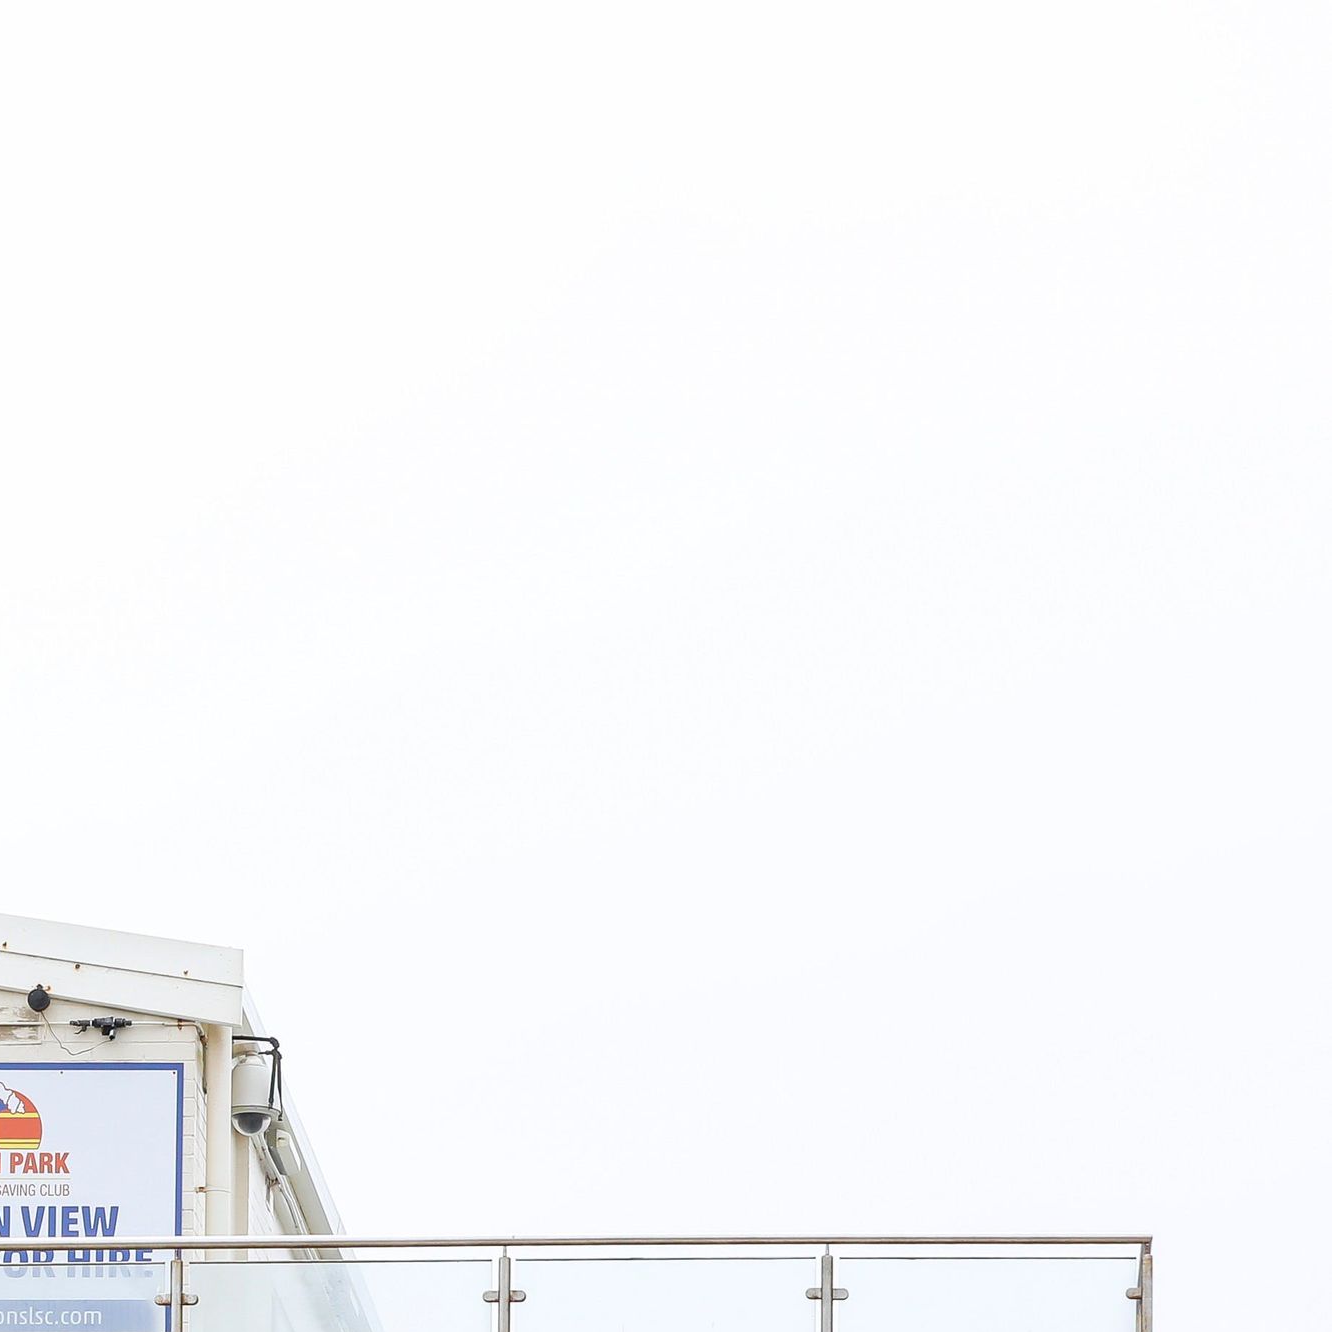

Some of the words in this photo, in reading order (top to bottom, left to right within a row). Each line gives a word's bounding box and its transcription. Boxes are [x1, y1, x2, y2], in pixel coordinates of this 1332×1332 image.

[9, 1152, 70, 1174] PARK
[39, 1184, 70, 1197] CLUB
[21, 1205, 119, 1238] VIEW
[67, 1248, 154, 1279] HIRE
